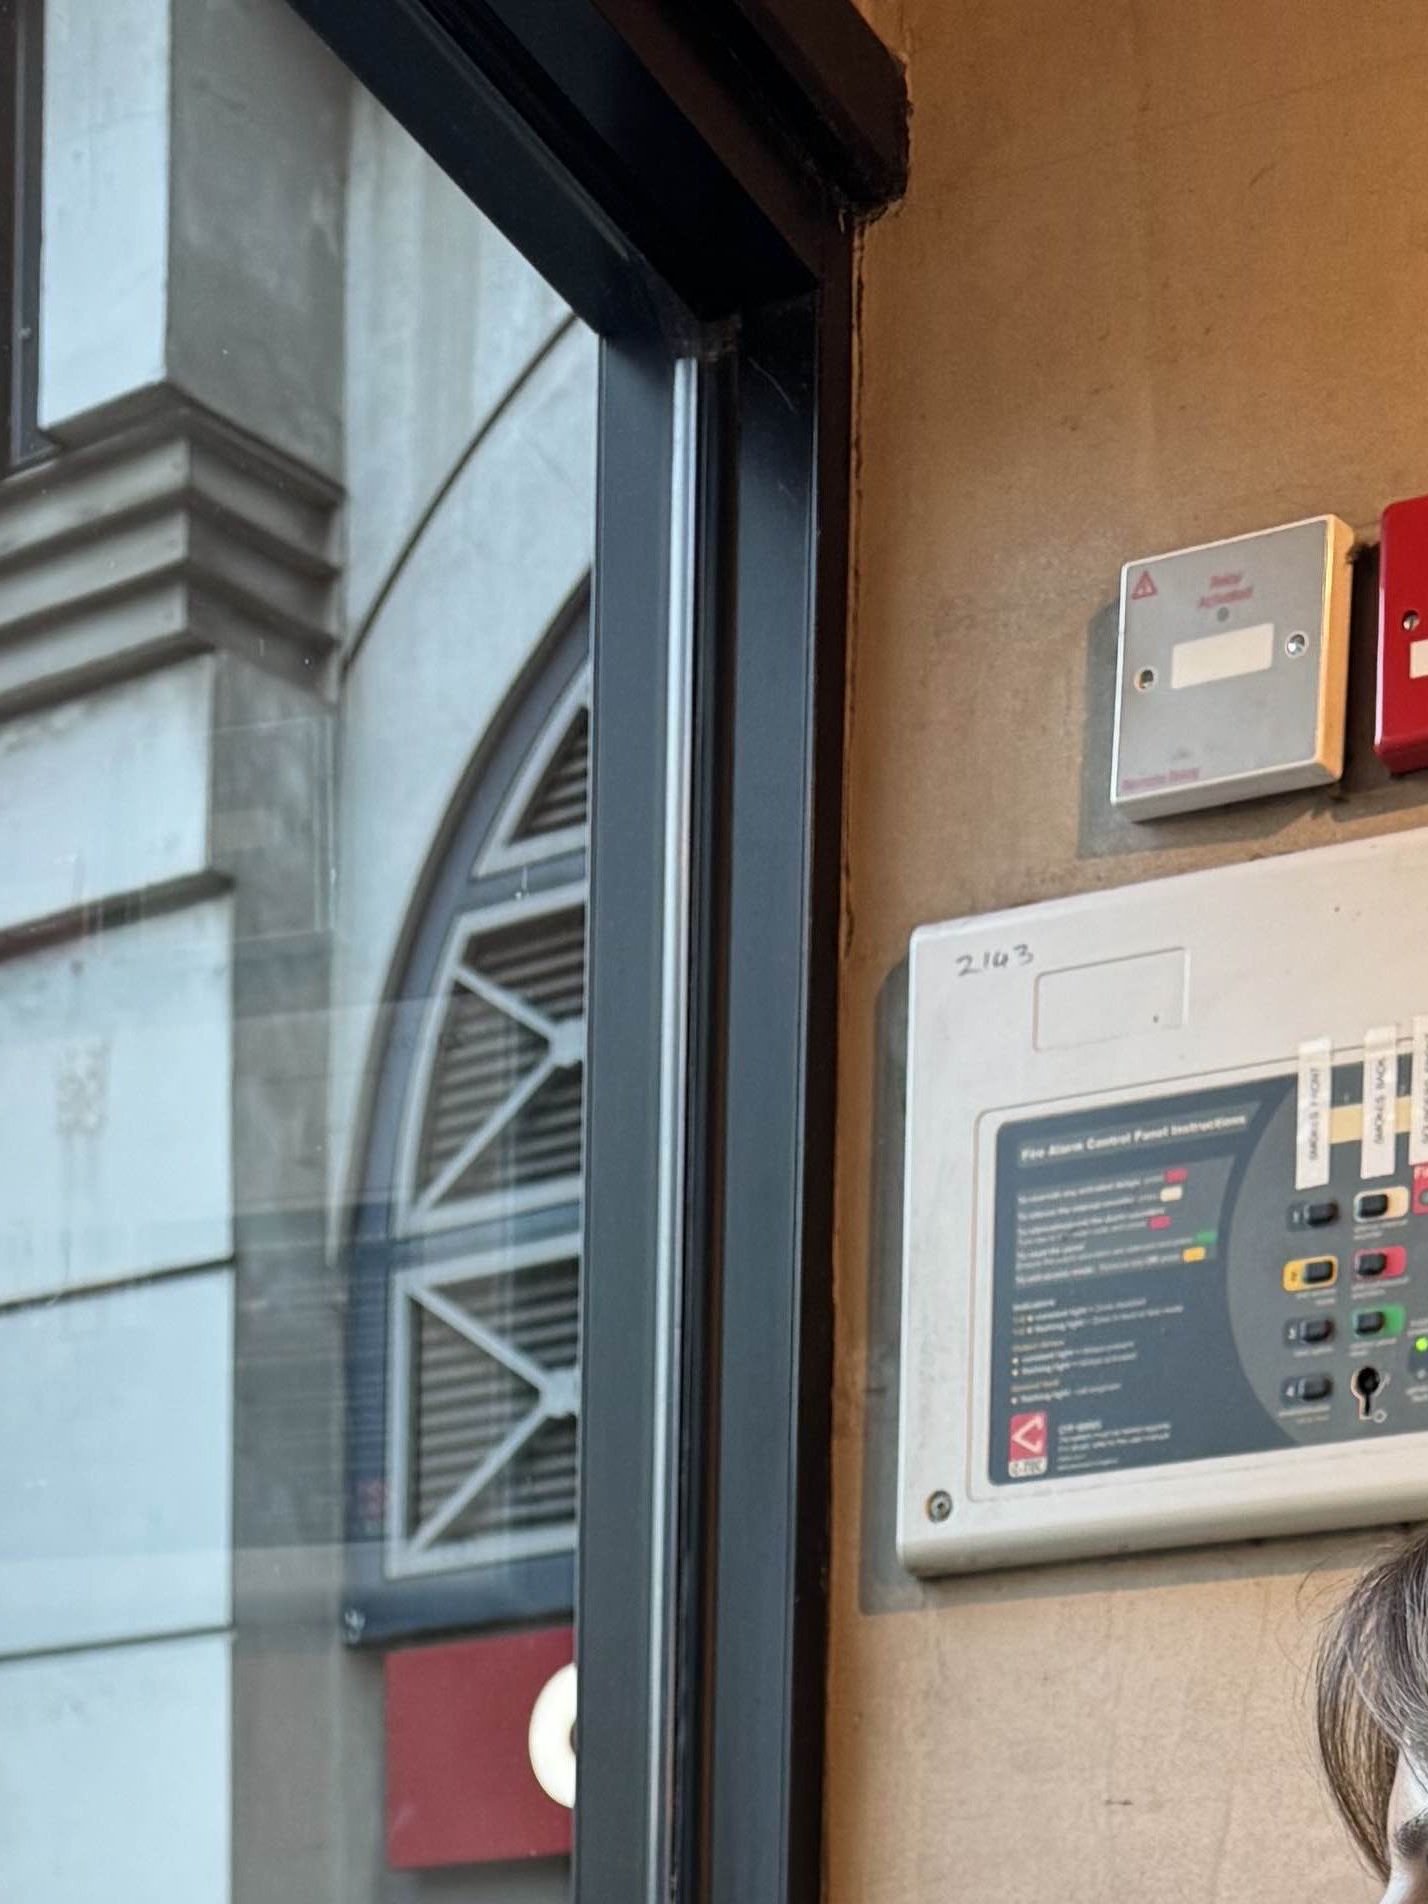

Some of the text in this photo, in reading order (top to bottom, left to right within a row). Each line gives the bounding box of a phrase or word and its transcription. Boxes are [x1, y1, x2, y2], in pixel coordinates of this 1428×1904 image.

[1086, 1132, 1132, 1151] Control
[1134, 1124, 1169, 1143] Panel
[1170, 1114, 1247, 1137] Instructions
